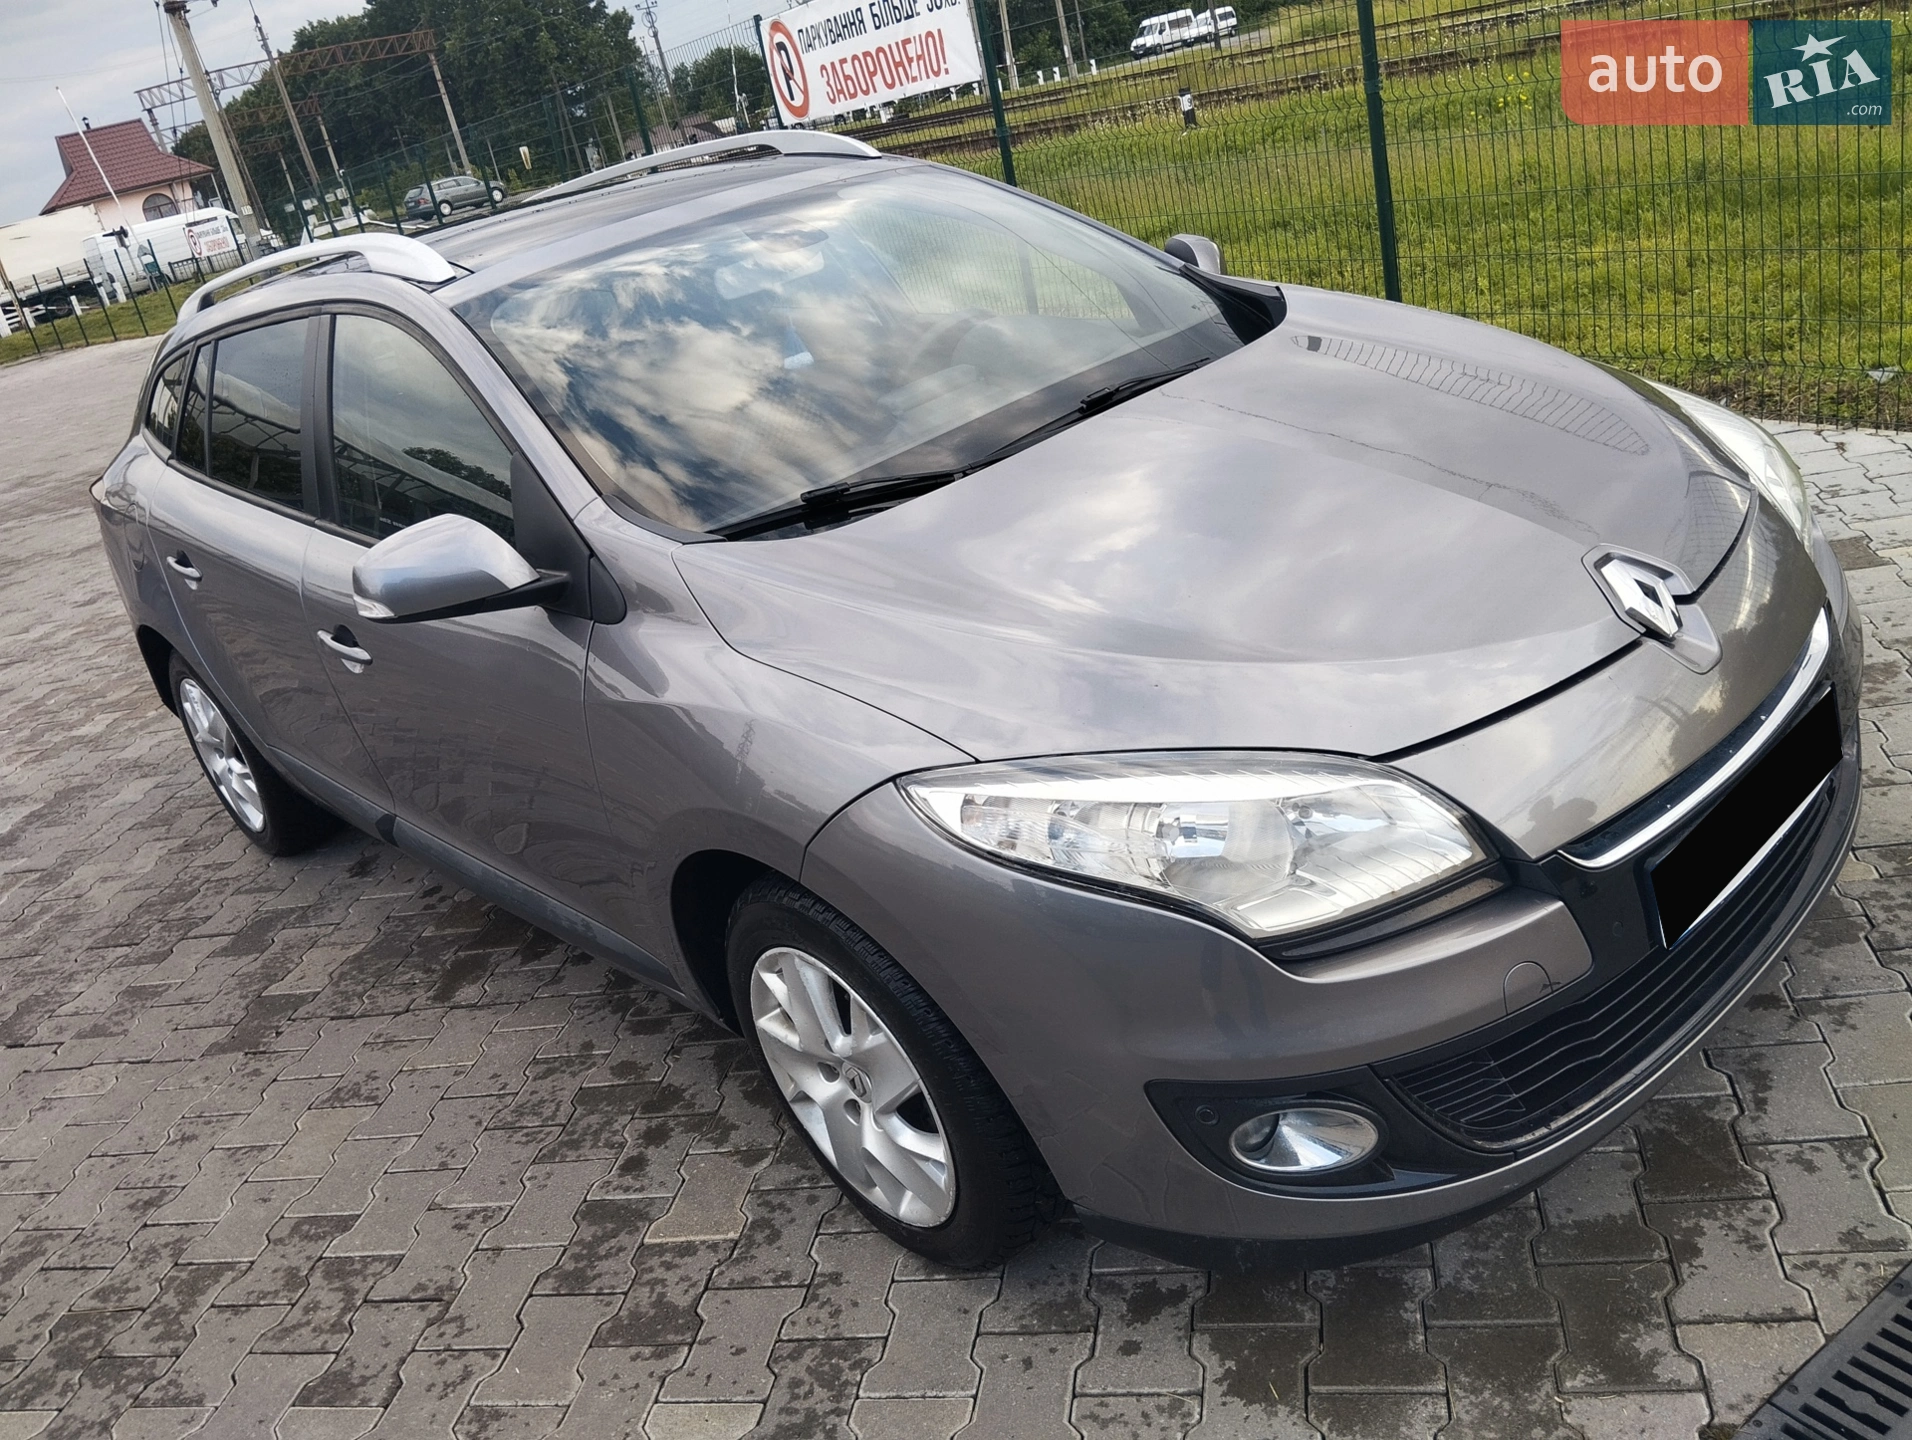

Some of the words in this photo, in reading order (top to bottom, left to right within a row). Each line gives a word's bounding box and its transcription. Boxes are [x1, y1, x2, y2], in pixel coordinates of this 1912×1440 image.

[797, 7, 867, 54] ПАРКУВАННЯ
[869, 0, 920, 30] БІЛЬШЕ
[820, 28, 949, 105] ЗАБОРОНЕНО!
